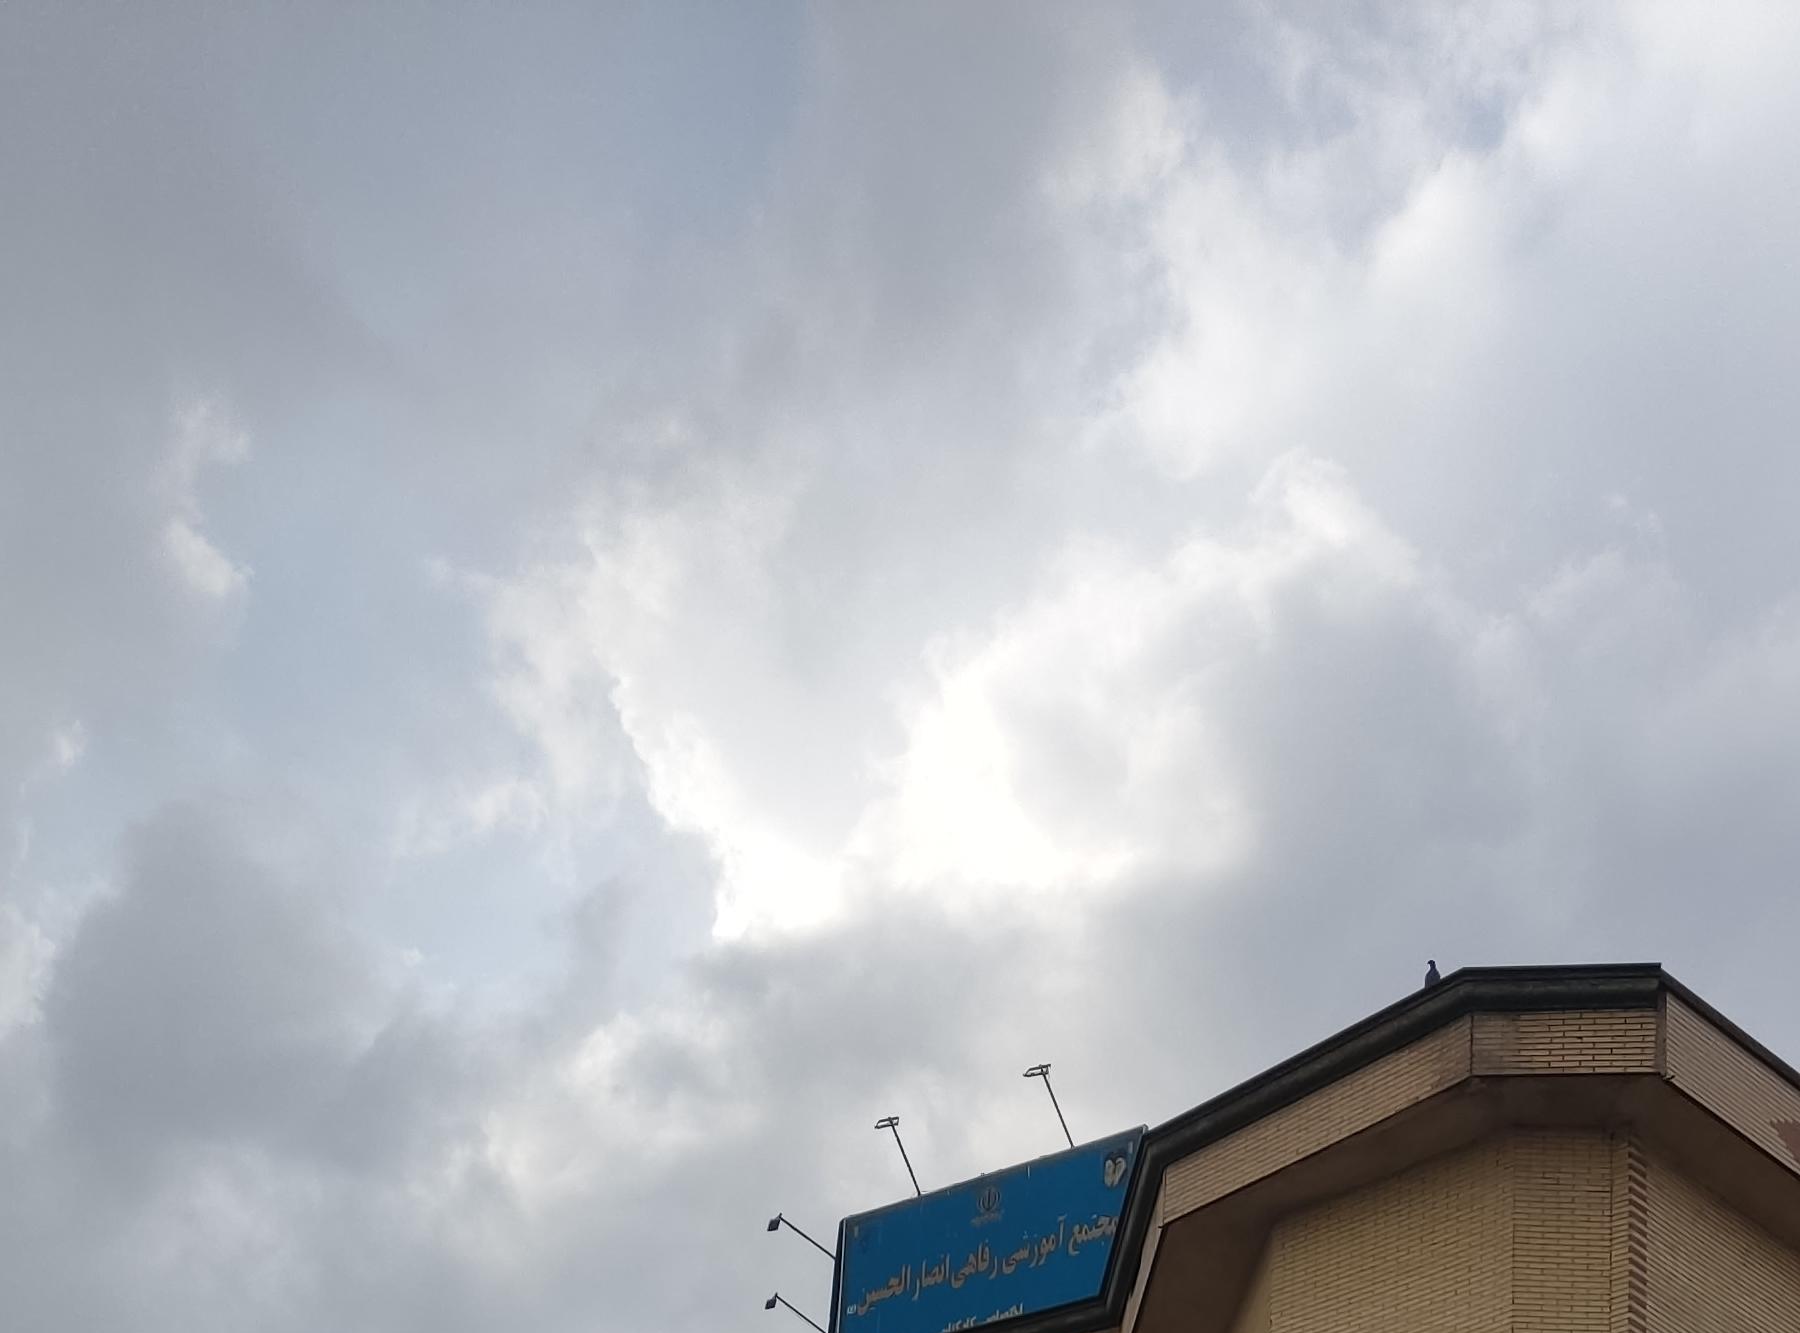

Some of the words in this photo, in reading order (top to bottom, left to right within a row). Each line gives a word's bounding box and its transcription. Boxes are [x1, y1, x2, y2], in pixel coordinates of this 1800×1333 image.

[1002, 1213, 1067, 1275] آموزشی
[1067, 1213, 1119, 1256] مجتمع
[912, 1252, 950, 1301] انصار
[951, 1239, 998, 1289] رفاهی
[857, 1263, 911, 1316] الحسین
